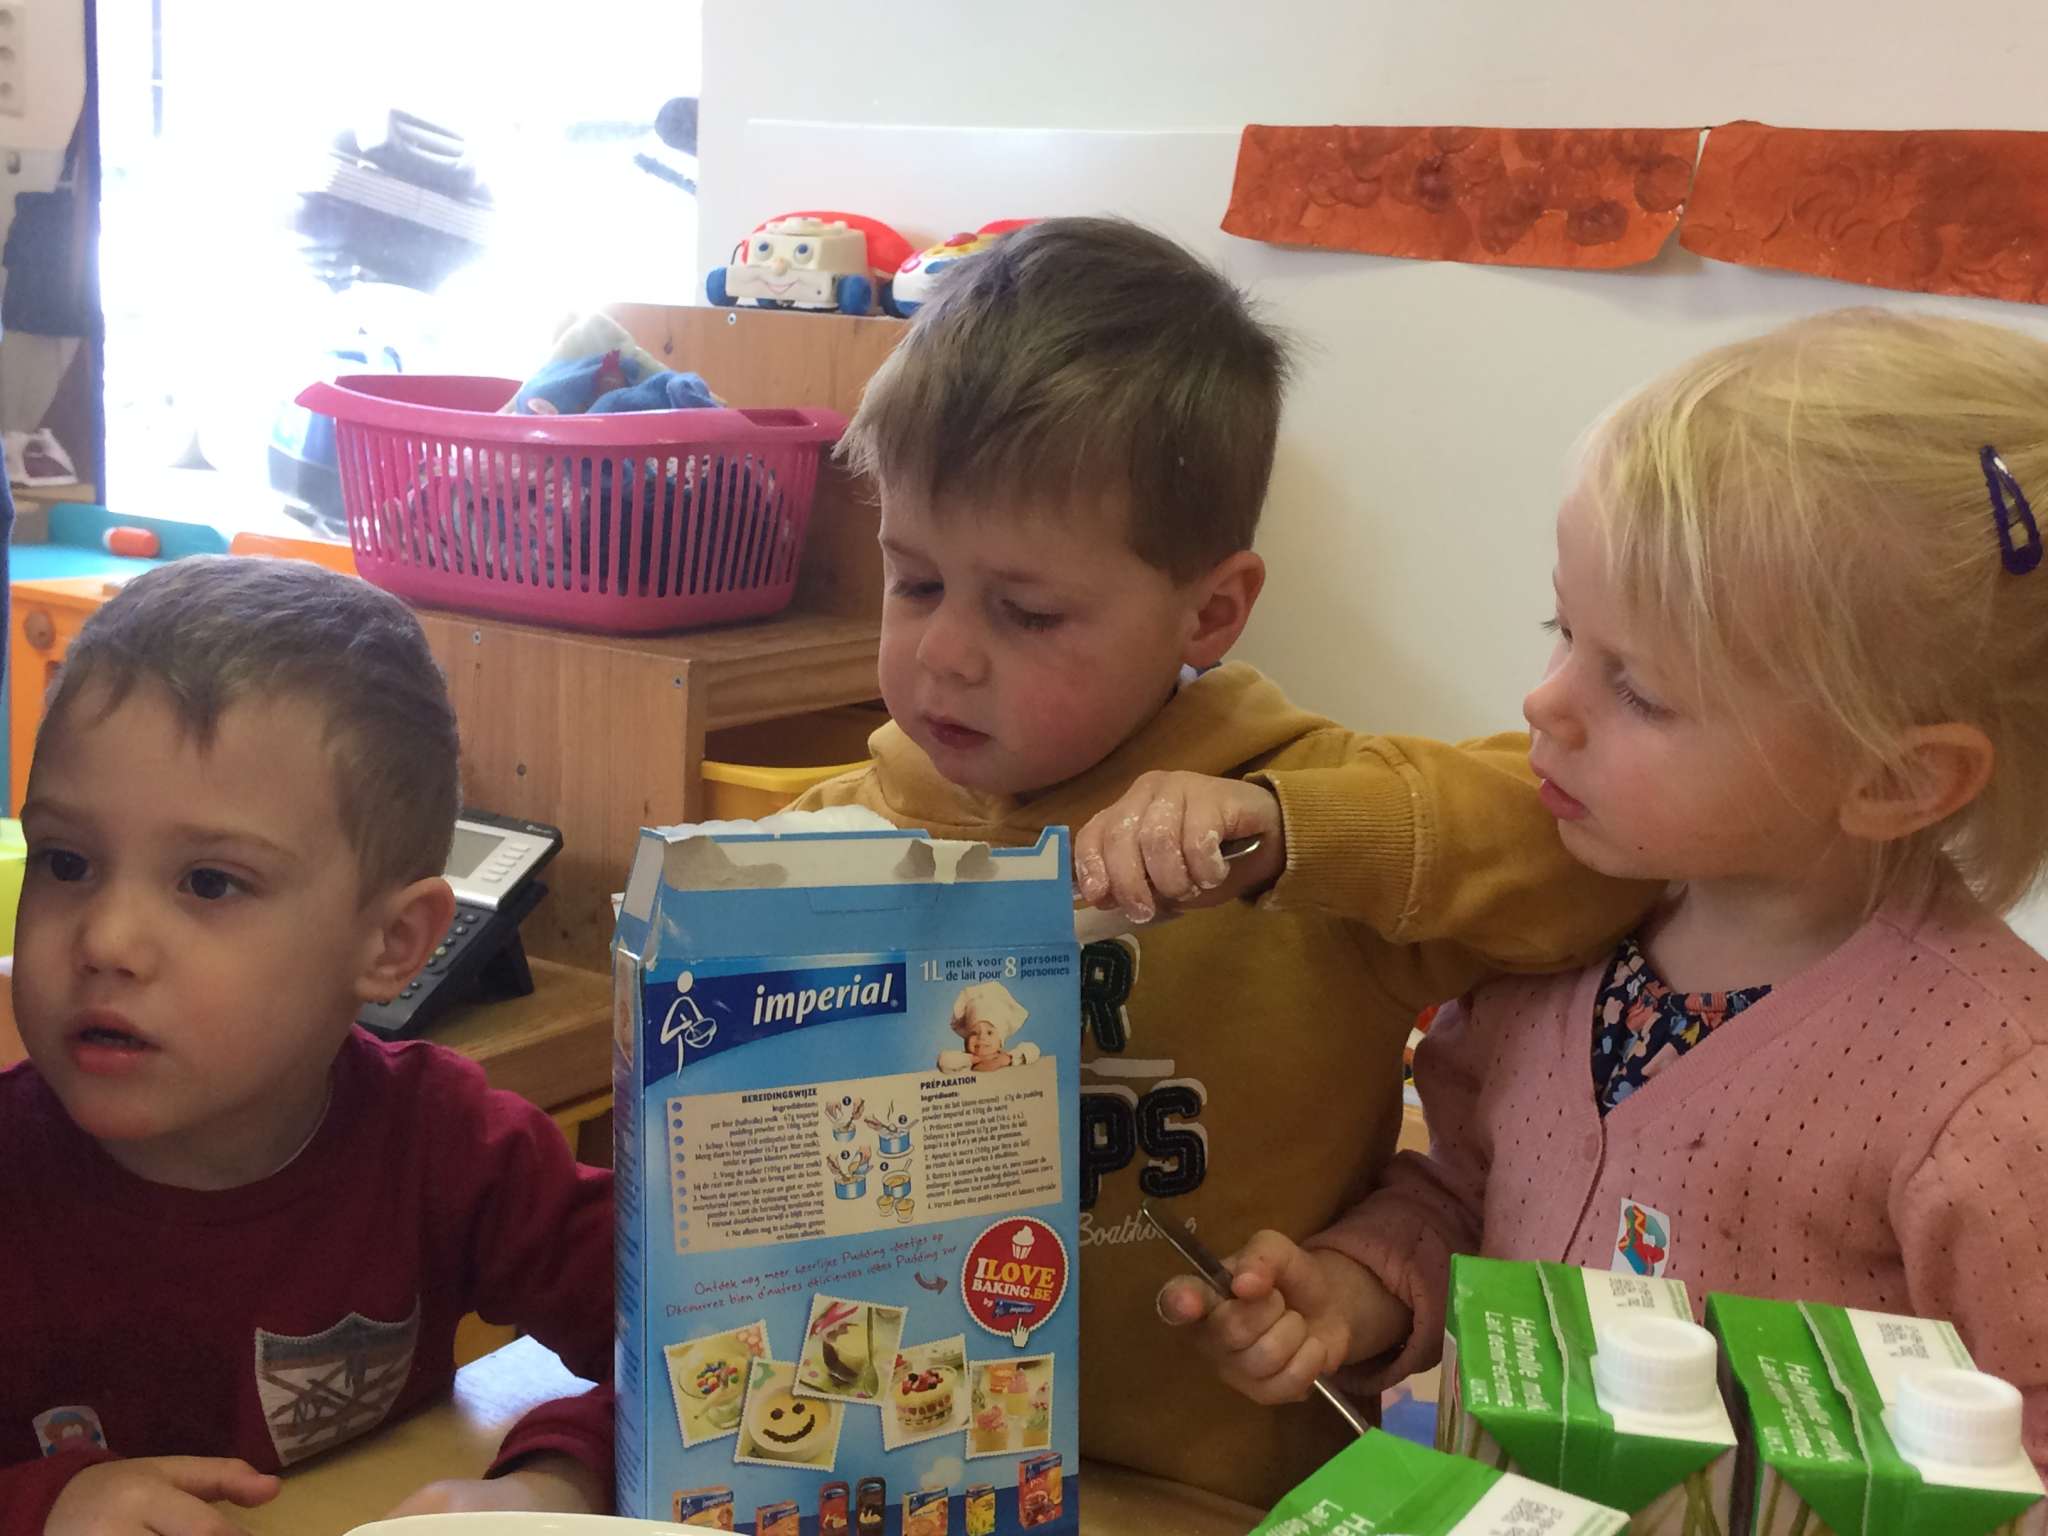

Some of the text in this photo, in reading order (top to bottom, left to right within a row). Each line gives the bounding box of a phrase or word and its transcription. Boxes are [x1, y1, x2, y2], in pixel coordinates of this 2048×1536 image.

[920, 954, 1070, 981] 1L melk voor 8 personen
[945, 967, 1070, 982] de lait pour personnes
[753, 973, 893, 1025] imperial
[742, 1088, 817, 1103] BEREIDINGSWIJZE
[920, 1076, 976, 1090] PRÉPARATION
[694, 1279, 737, 1295] Ontdek
[741, 1275, 760, 1288] nog
[764, 1269, 789, 1279] meer
[842, 1248, 886, 1264] Pudding
[729, 1292, 753, 1305] bien
[758, 1282, 802, 1300] d'autres
[896, 1250, 938, 1267] Pudding
[971, 1279, 1053, 1302] BAKING.BE
[1511, 1316, 1544, 1379] Halfvolle
